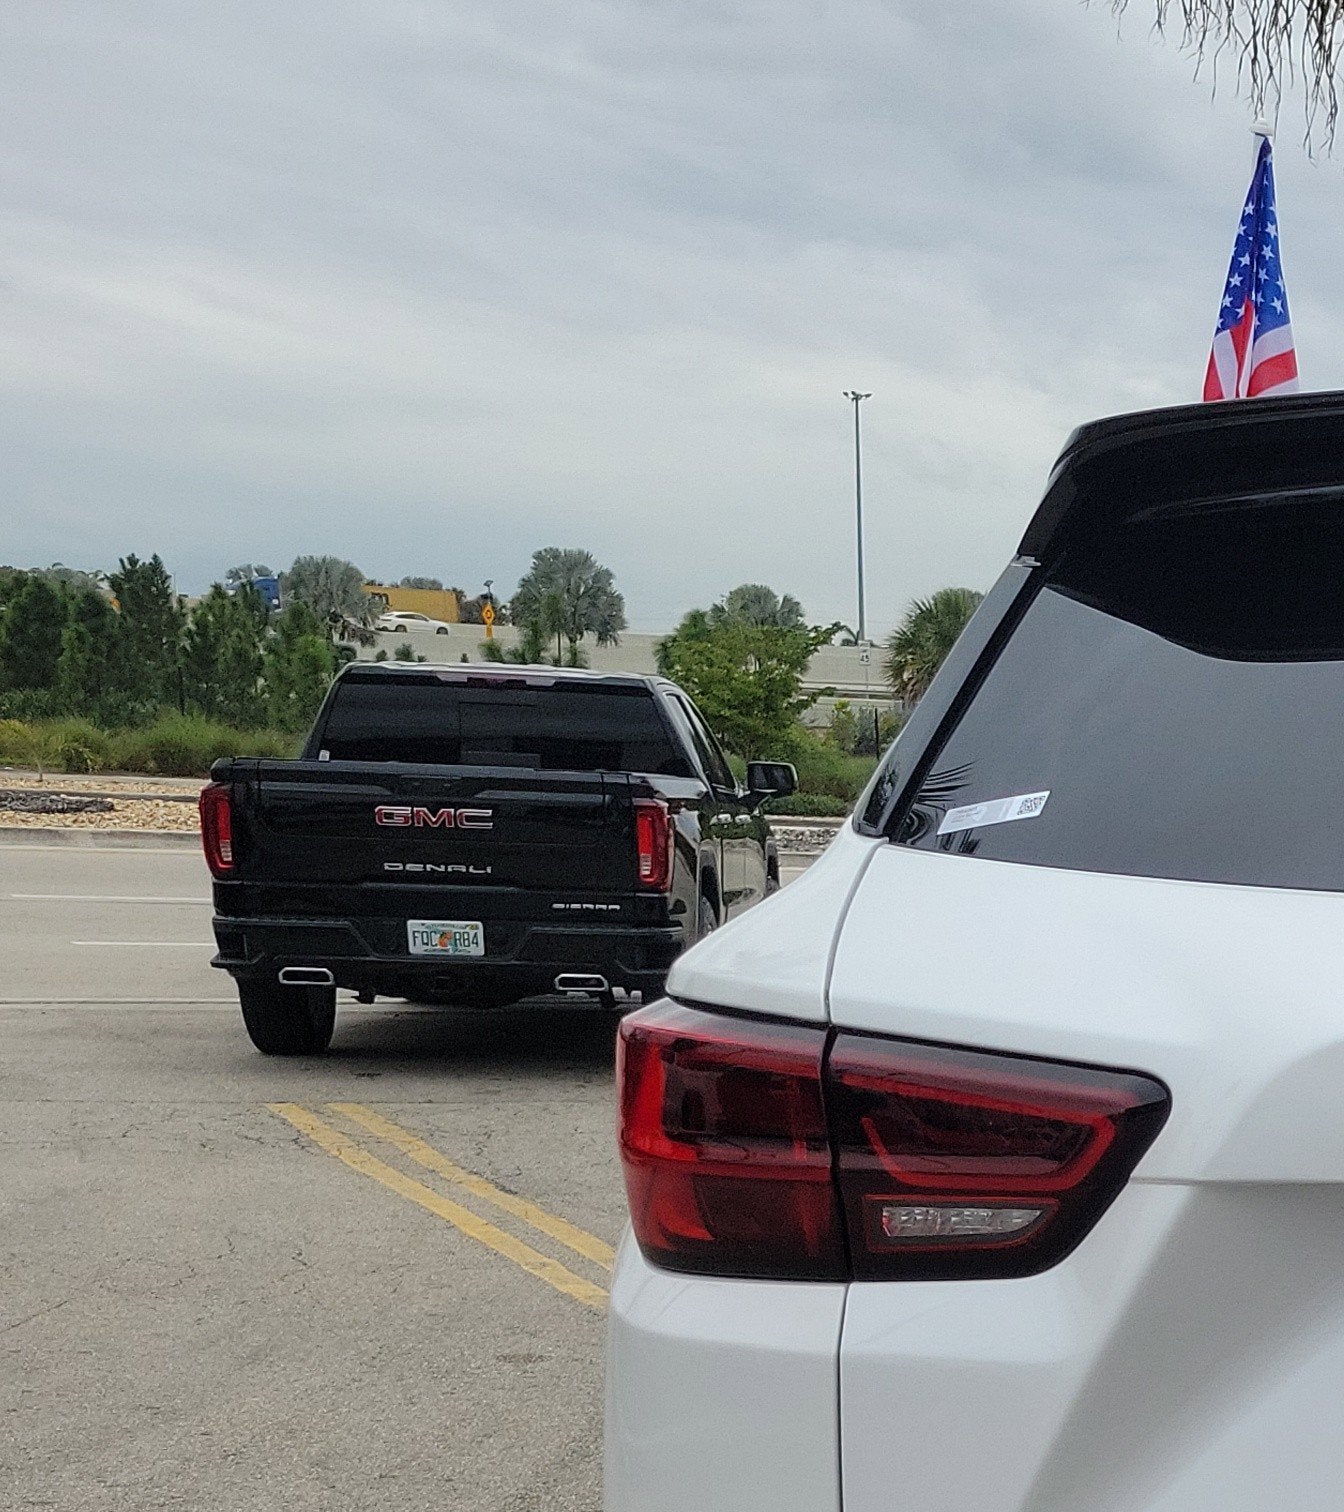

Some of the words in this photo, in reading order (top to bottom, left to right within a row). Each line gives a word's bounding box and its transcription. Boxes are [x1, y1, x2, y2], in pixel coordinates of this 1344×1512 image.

[375, 805, 494, 829] GMC
[383, 862, 492, 875] DENALI
[551, 903, 621, 911] SIERRA
